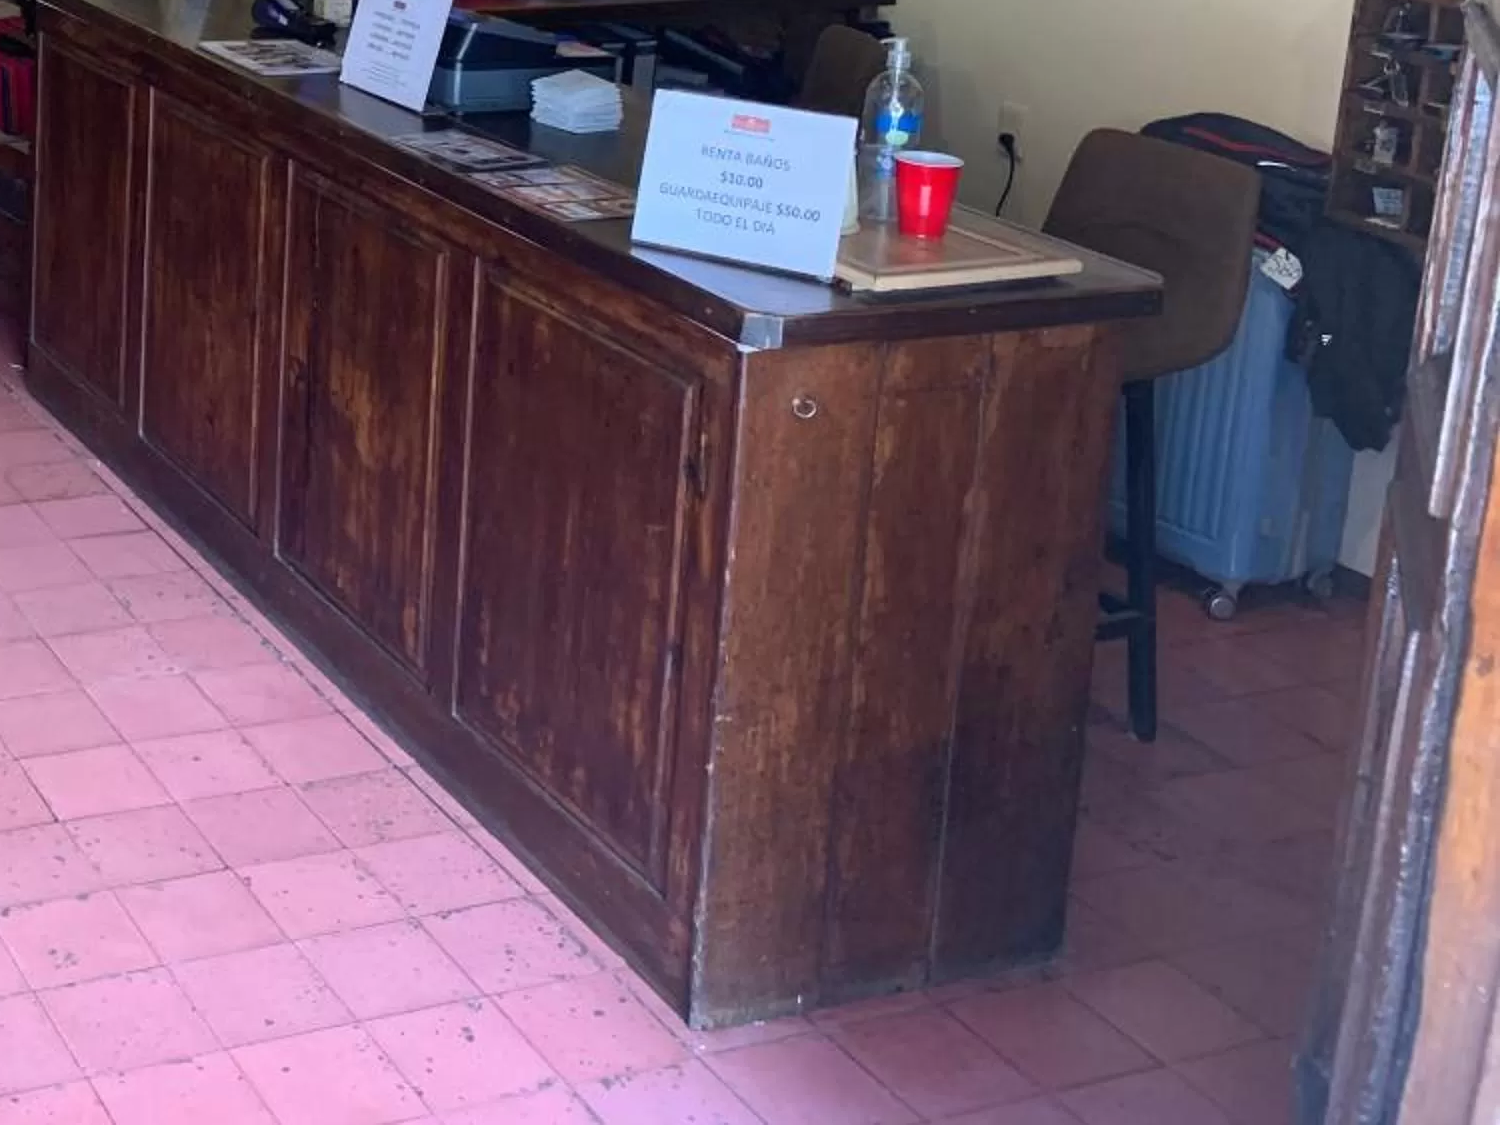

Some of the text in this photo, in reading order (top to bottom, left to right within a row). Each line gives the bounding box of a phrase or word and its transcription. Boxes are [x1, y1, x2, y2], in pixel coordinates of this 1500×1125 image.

[700, 146, 742, 163] RENTA
[720, 171, 764, 189] $10.00
[659, 182, 821, 222] GUARDAEQUIPAJE $50.00
[695, 207, 733, 226] TODO
[735, 216, 749, 231] EL
